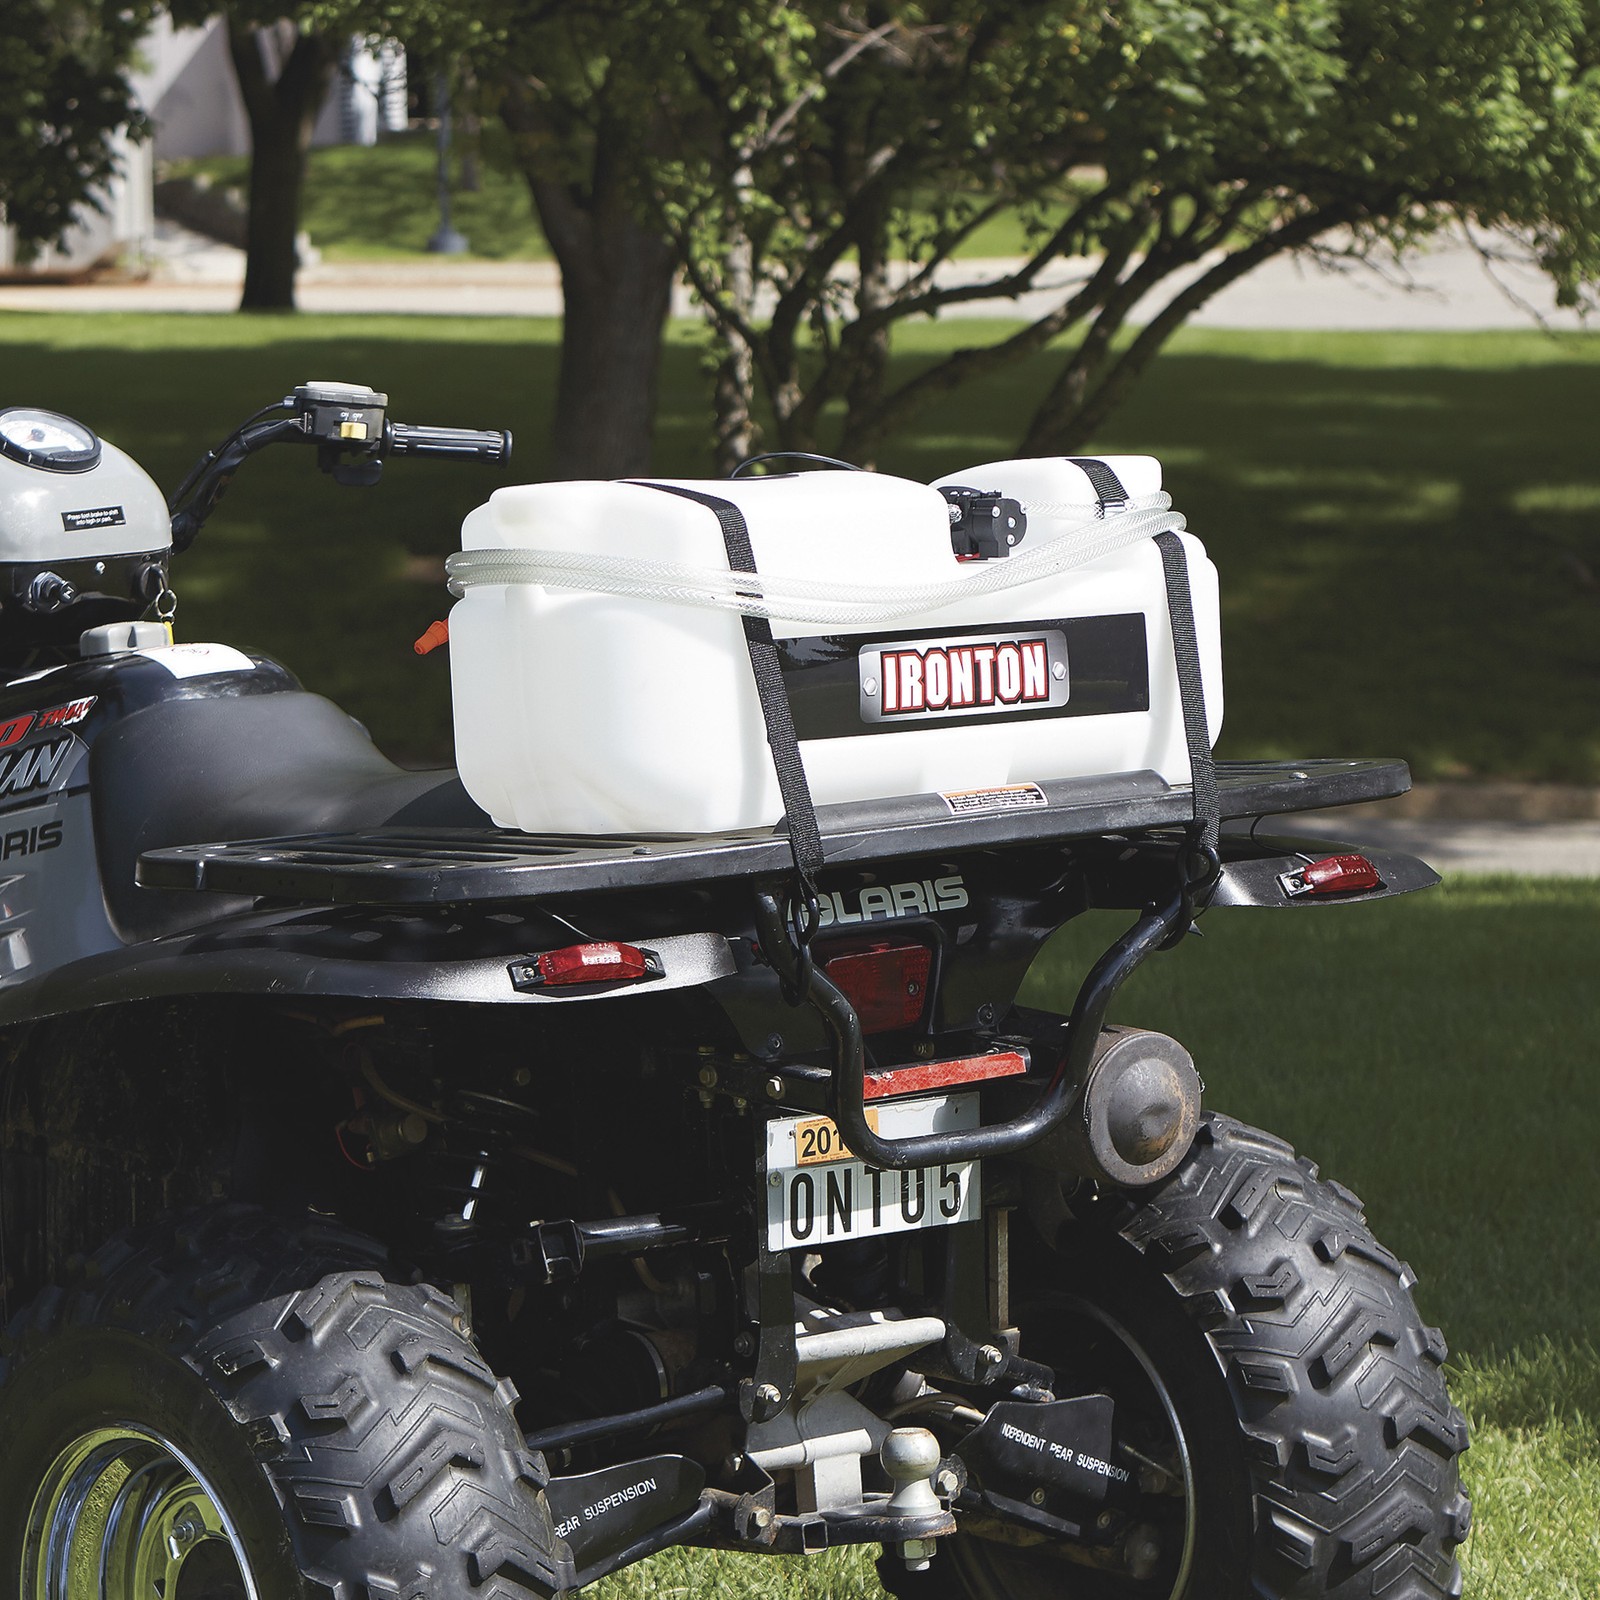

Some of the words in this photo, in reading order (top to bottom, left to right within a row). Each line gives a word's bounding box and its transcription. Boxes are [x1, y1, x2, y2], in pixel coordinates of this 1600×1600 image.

[881, 640, 1048, 714] IRONTON
[787, 875, 969, 927] OLARIS
[1076, 1453, 1130, 1482] SUSPENSION
[584, 1477, 657, 1520] SUSPENSION
